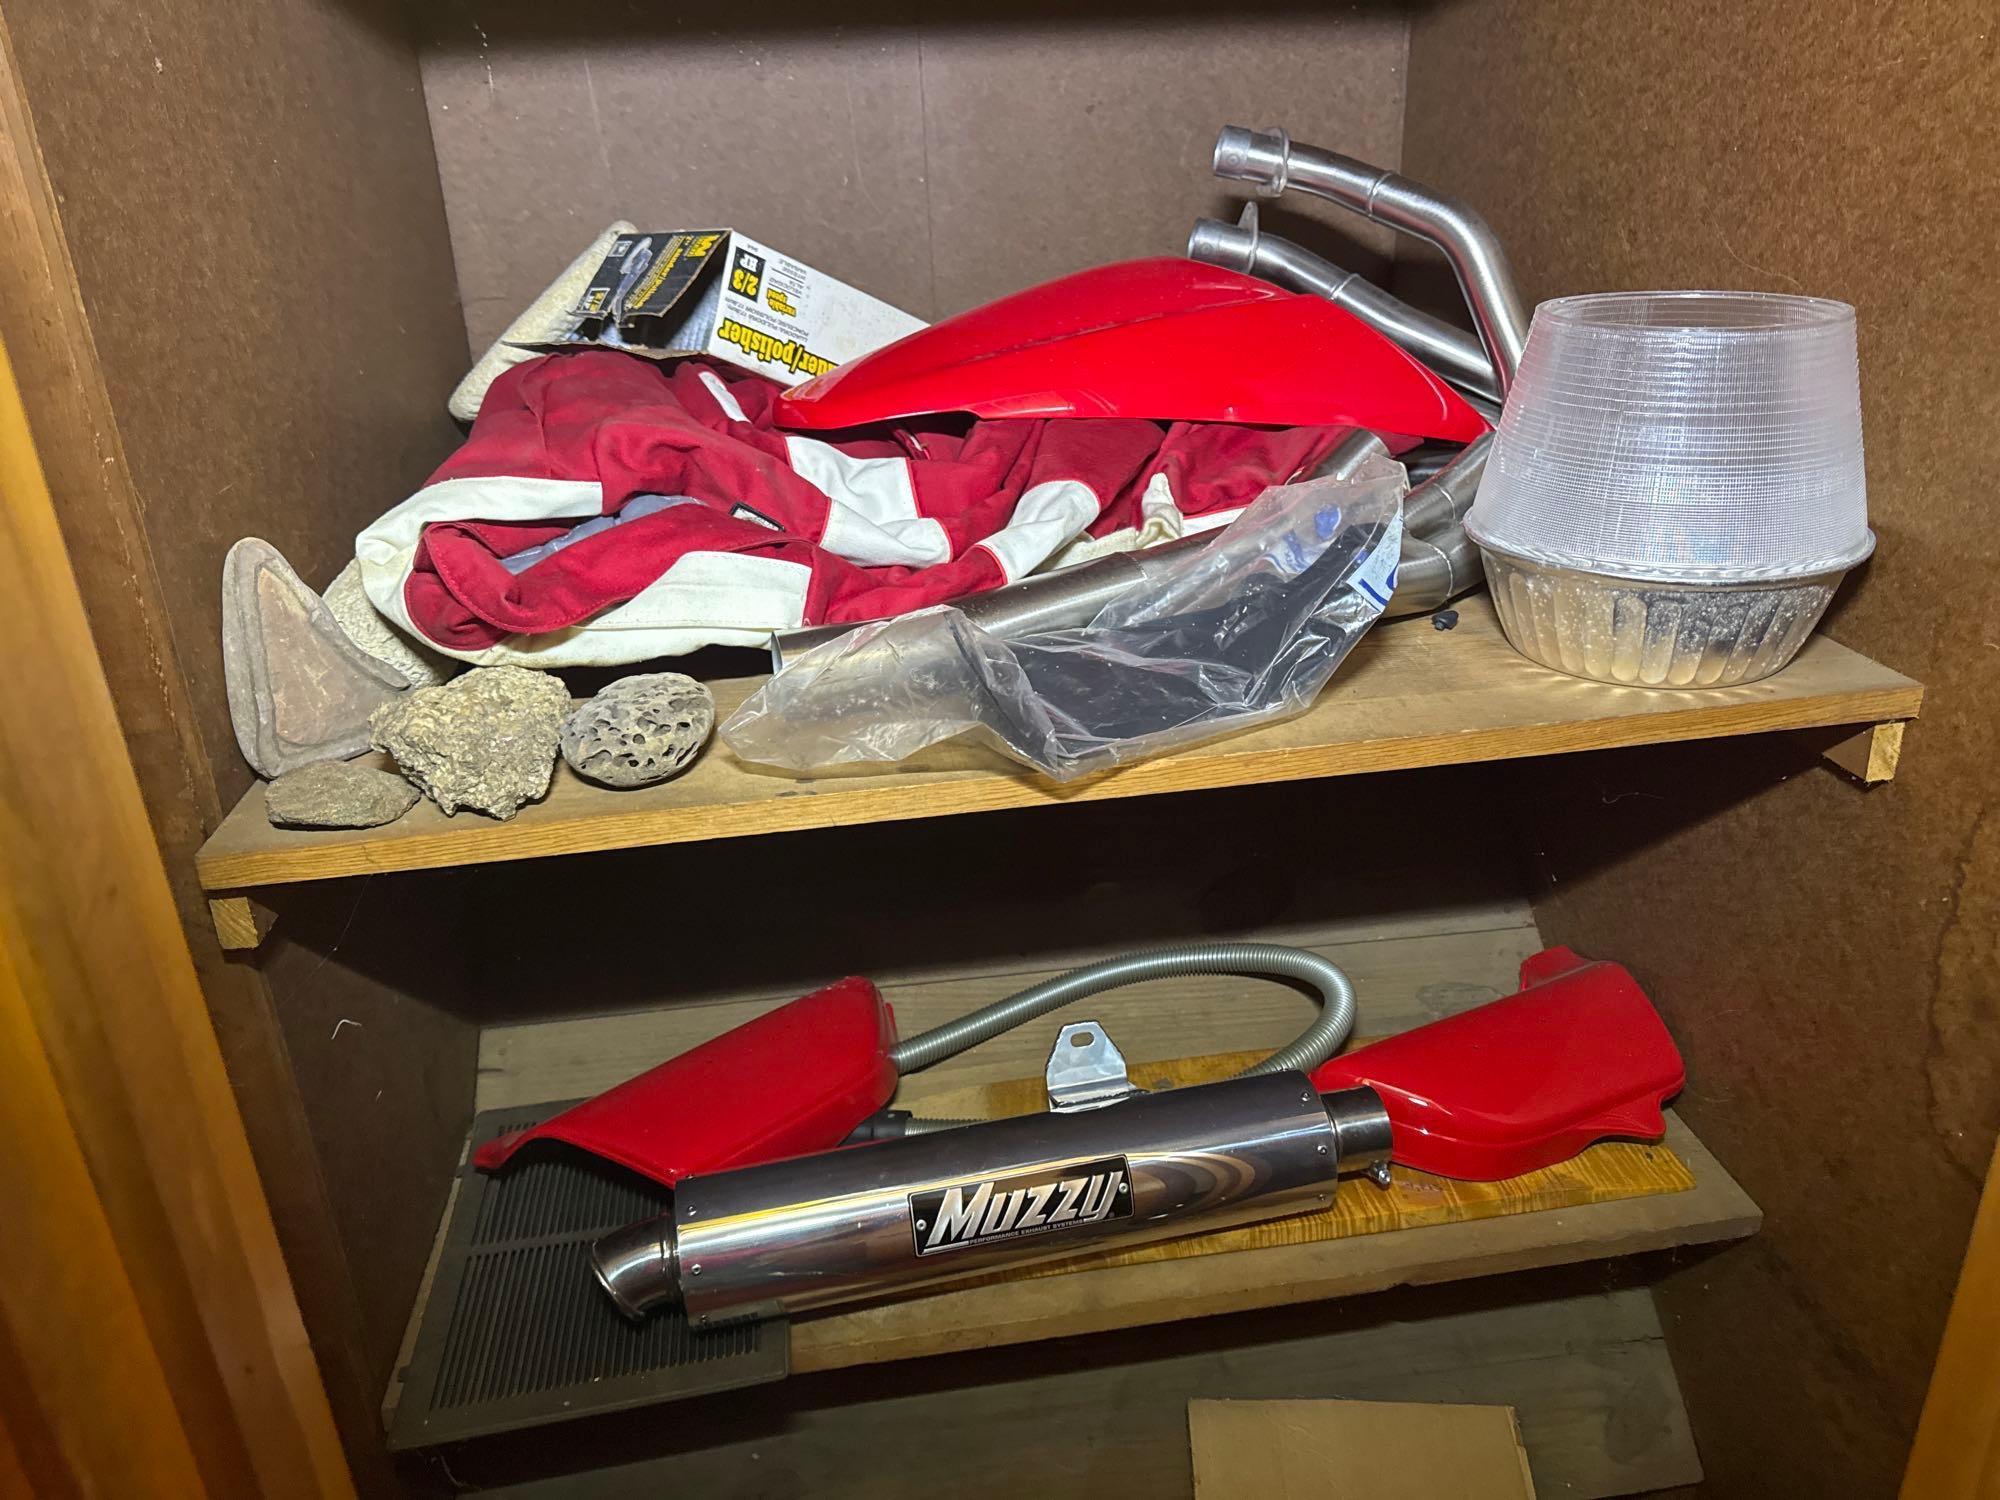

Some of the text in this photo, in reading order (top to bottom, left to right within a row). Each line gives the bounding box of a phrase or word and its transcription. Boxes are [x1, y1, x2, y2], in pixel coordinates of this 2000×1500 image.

[739, 253, 759, 272] HP
[732, 269, 759, 296] 2/3
[718, 317, 839, 376] der/polisher
[969, 1218, 1084, 1246] PERFORMANCE EXHAUST SYSTEMS
